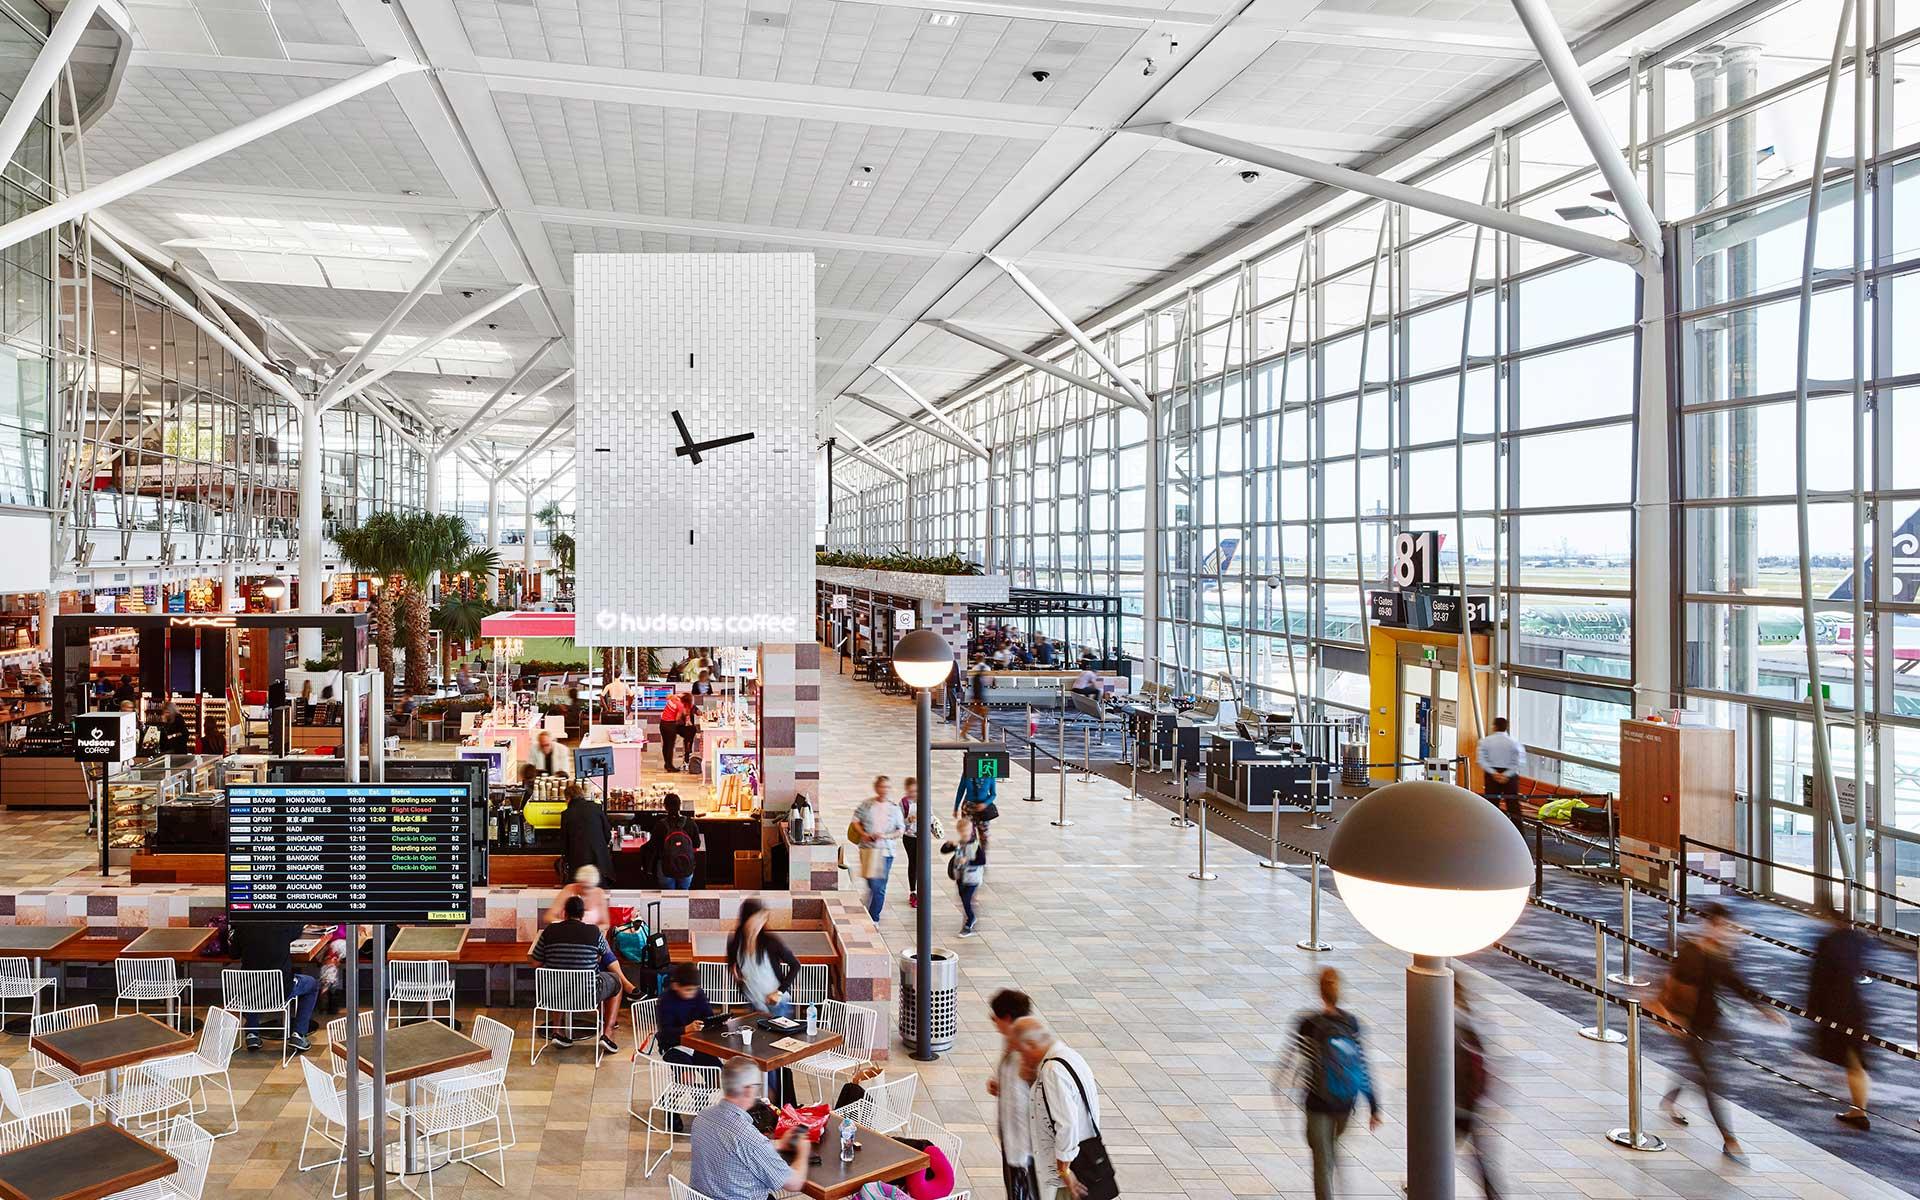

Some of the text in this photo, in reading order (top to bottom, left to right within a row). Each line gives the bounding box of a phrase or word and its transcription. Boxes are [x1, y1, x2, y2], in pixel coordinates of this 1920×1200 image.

[1395, 532, 1431, 587] 81
[1378, 596, 1393, 606] Gates
[1432, 600, 1449, 611] Gates
[1432, 612, 1449, 622] 82-87
[1466, 602, 1486, 621] 81
[620, 612, 796, 632] hudsons coffee
[78, 739, 115, 747] hudsons
